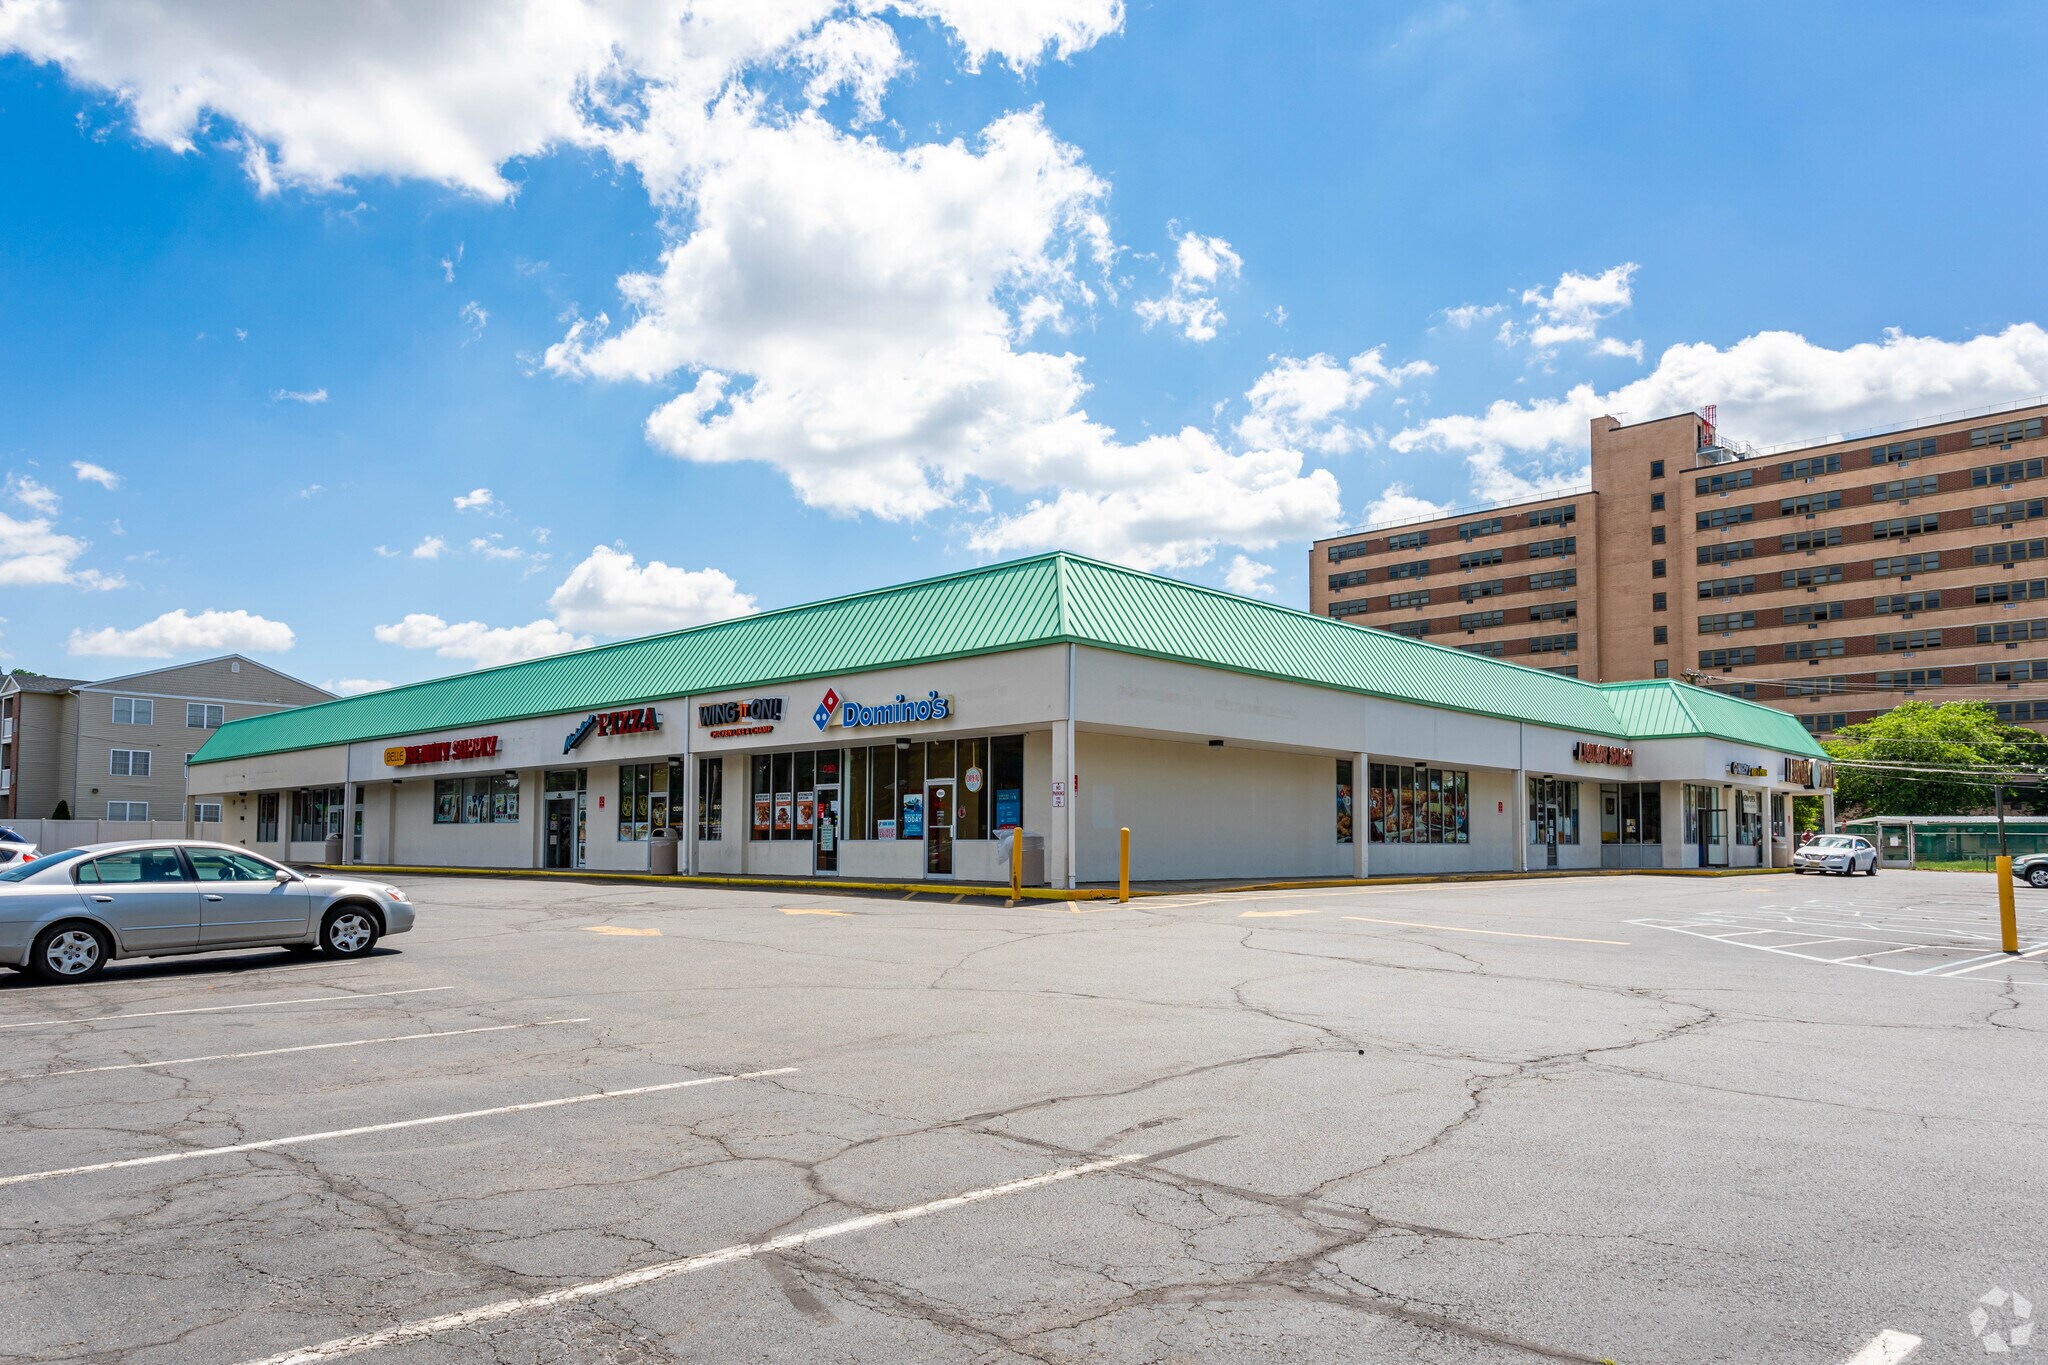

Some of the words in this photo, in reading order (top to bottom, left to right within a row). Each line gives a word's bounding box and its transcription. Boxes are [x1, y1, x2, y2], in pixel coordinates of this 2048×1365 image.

[597, 707, 659, 737] PIZZA
[699, 702, 738, 726] WING
[739, 704, 750, 717] IT
[750, 698, 782, 720] ON!
[842, 690, 949, 728] Domino's
[710, 729, 734, 738] CHICKEN
[733, 728, 745, 736] LIKE
[751, 725, 774, 735] CHAMP
[386, 750, 405, 762] BELLE
[404, 742, 452, 765] BEAUTY
[452, 736, 499, 760] SUPPLY
[1577, 741, 1609, 764] LIQUOR
